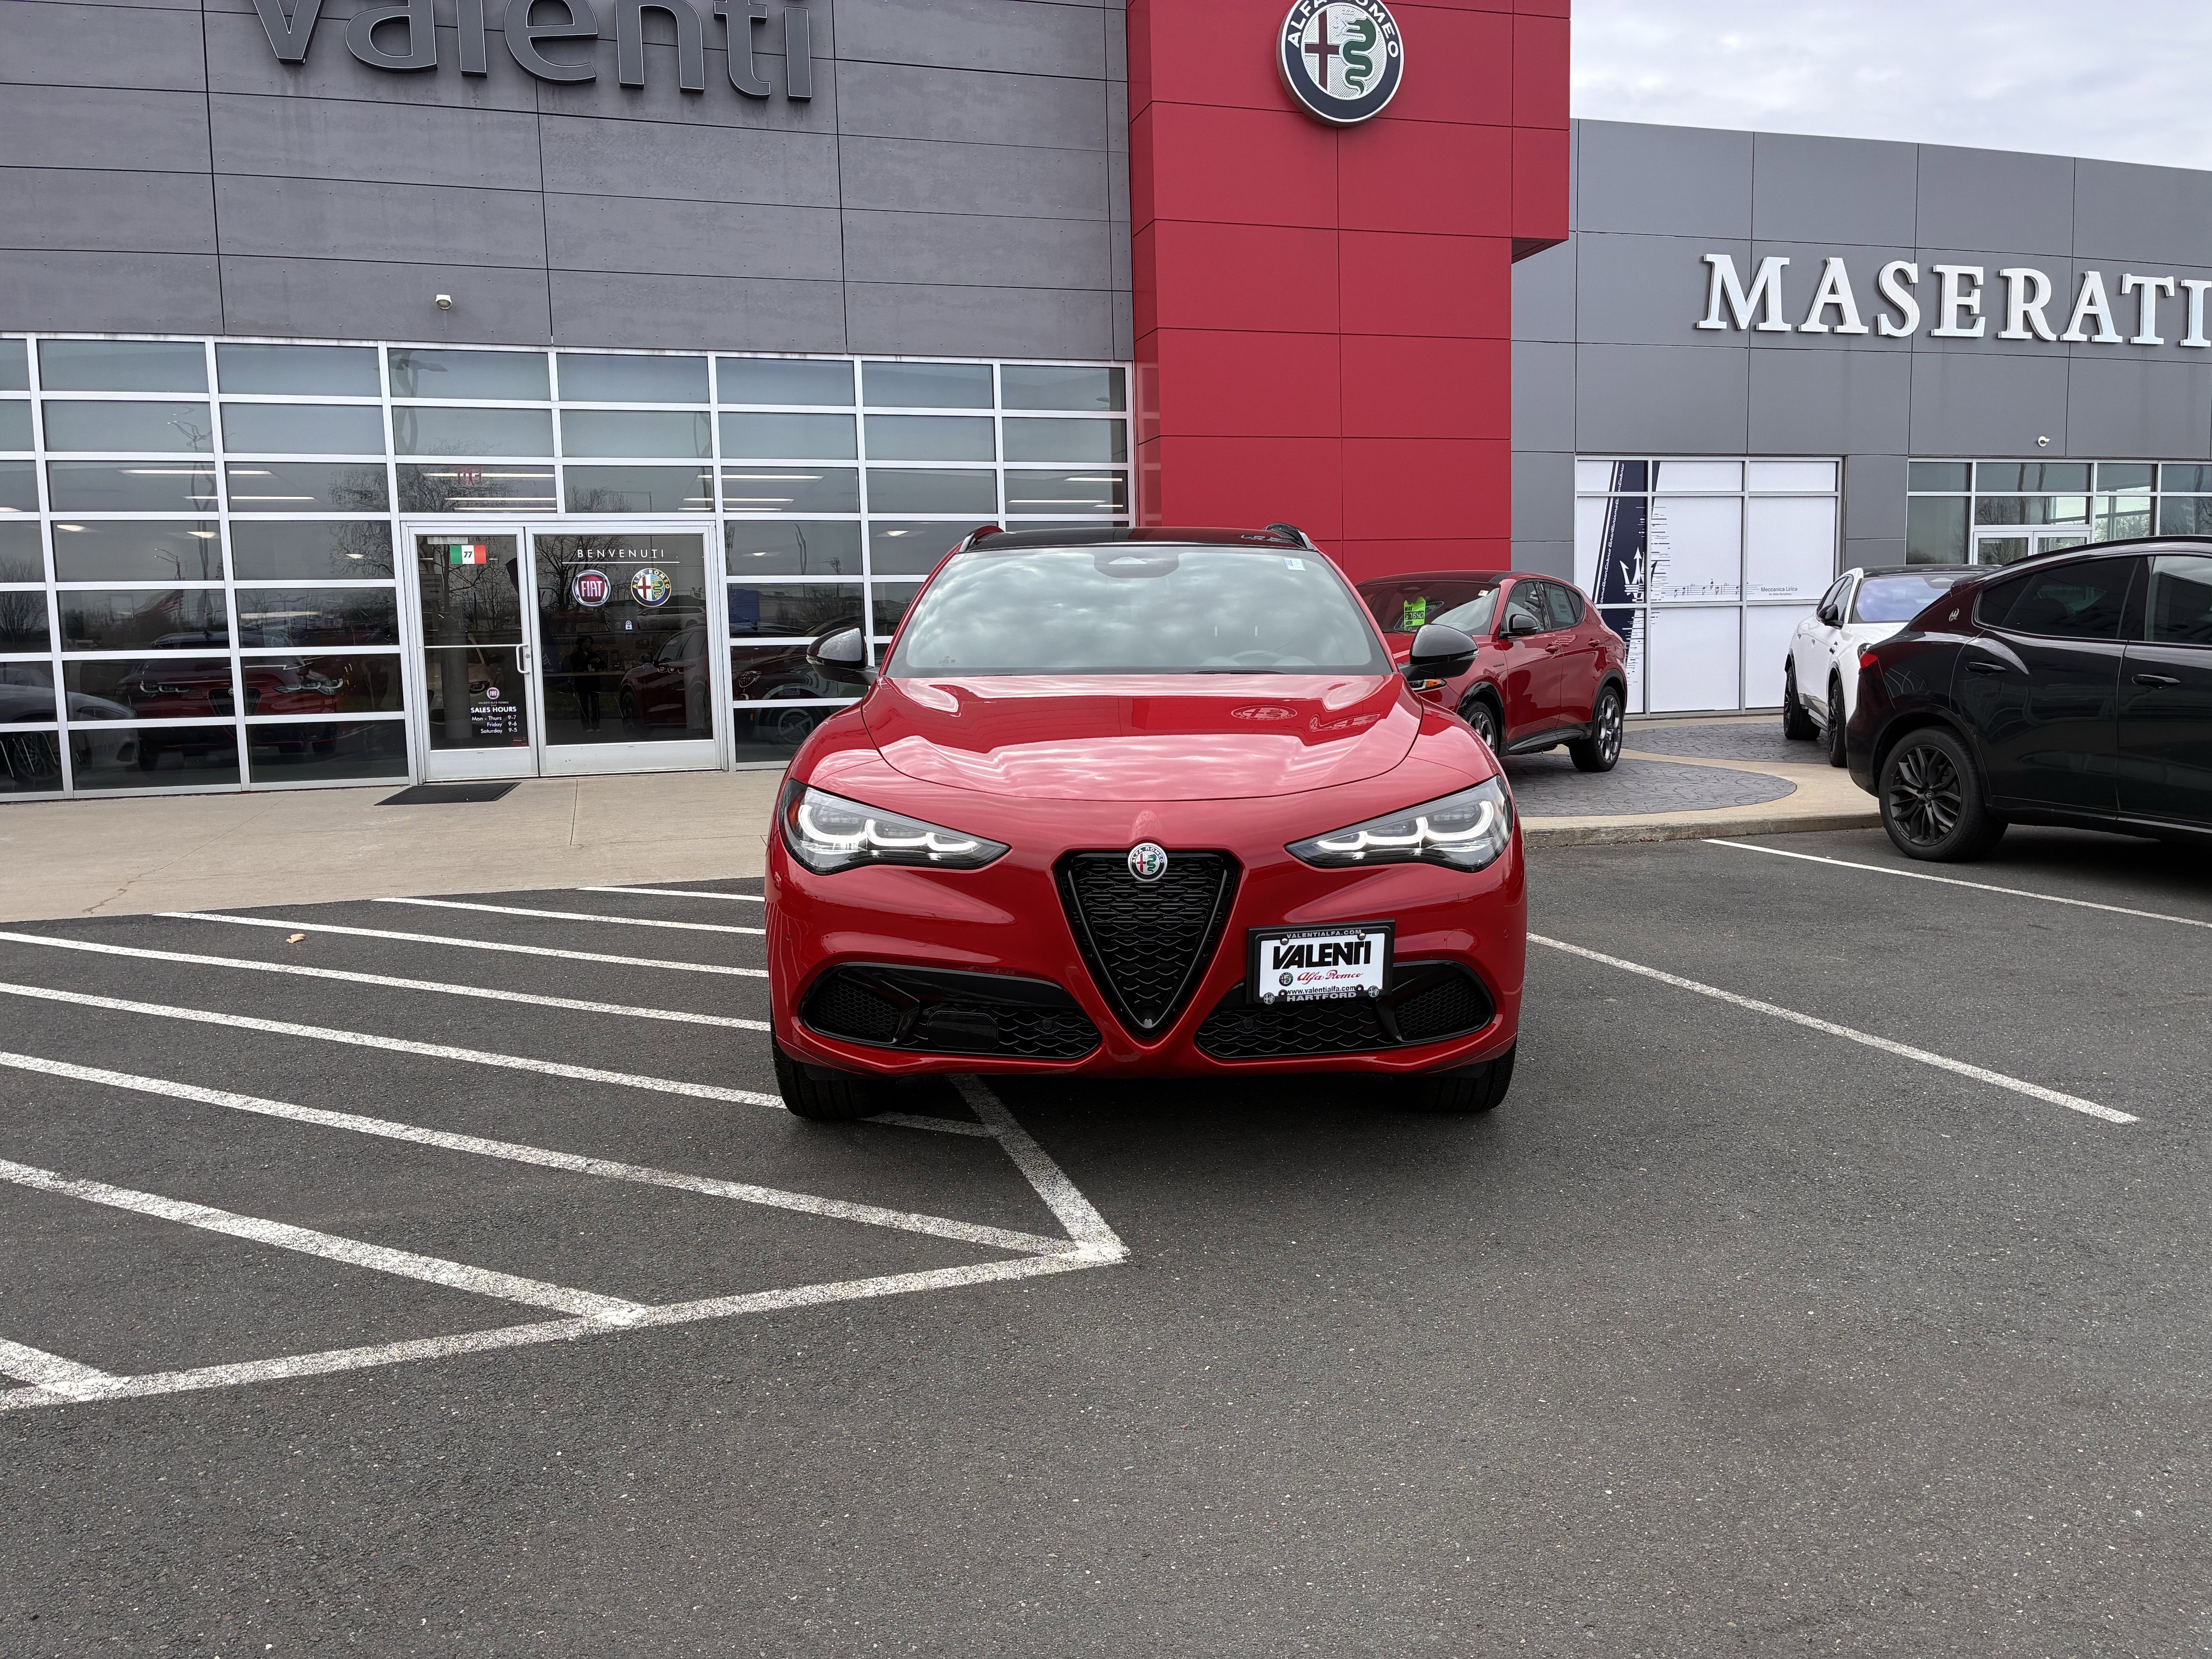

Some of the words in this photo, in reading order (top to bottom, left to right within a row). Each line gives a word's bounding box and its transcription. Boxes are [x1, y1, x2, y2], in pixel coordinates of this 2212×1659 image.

[1354, 0, 1399, 58] MEO
[1697, 254, 2212, 347] MASERATI
[577, 549, 664, 558] BENVENUTI
[632, 572, 646, 589] ALFA
[649, 569, 670, 589] ROMEO
[581, 580, 603, 597] FIAT
[1132, 849, 1144, 864] ALFA
[1145, 847, 1164, 863] ROMEO
[1286, 929, 1362, 939] VALENTIALFA.COM
[1273, 941, 1372, 970] VALENTI
[1297, 971, 1324, 985] Alfa
[1325, 969, 1364, 979] Romeo
[1286, 986, 1356, 994] www.valentialfa.com
[1286, 992, 1357, 1002] HARTFORD
